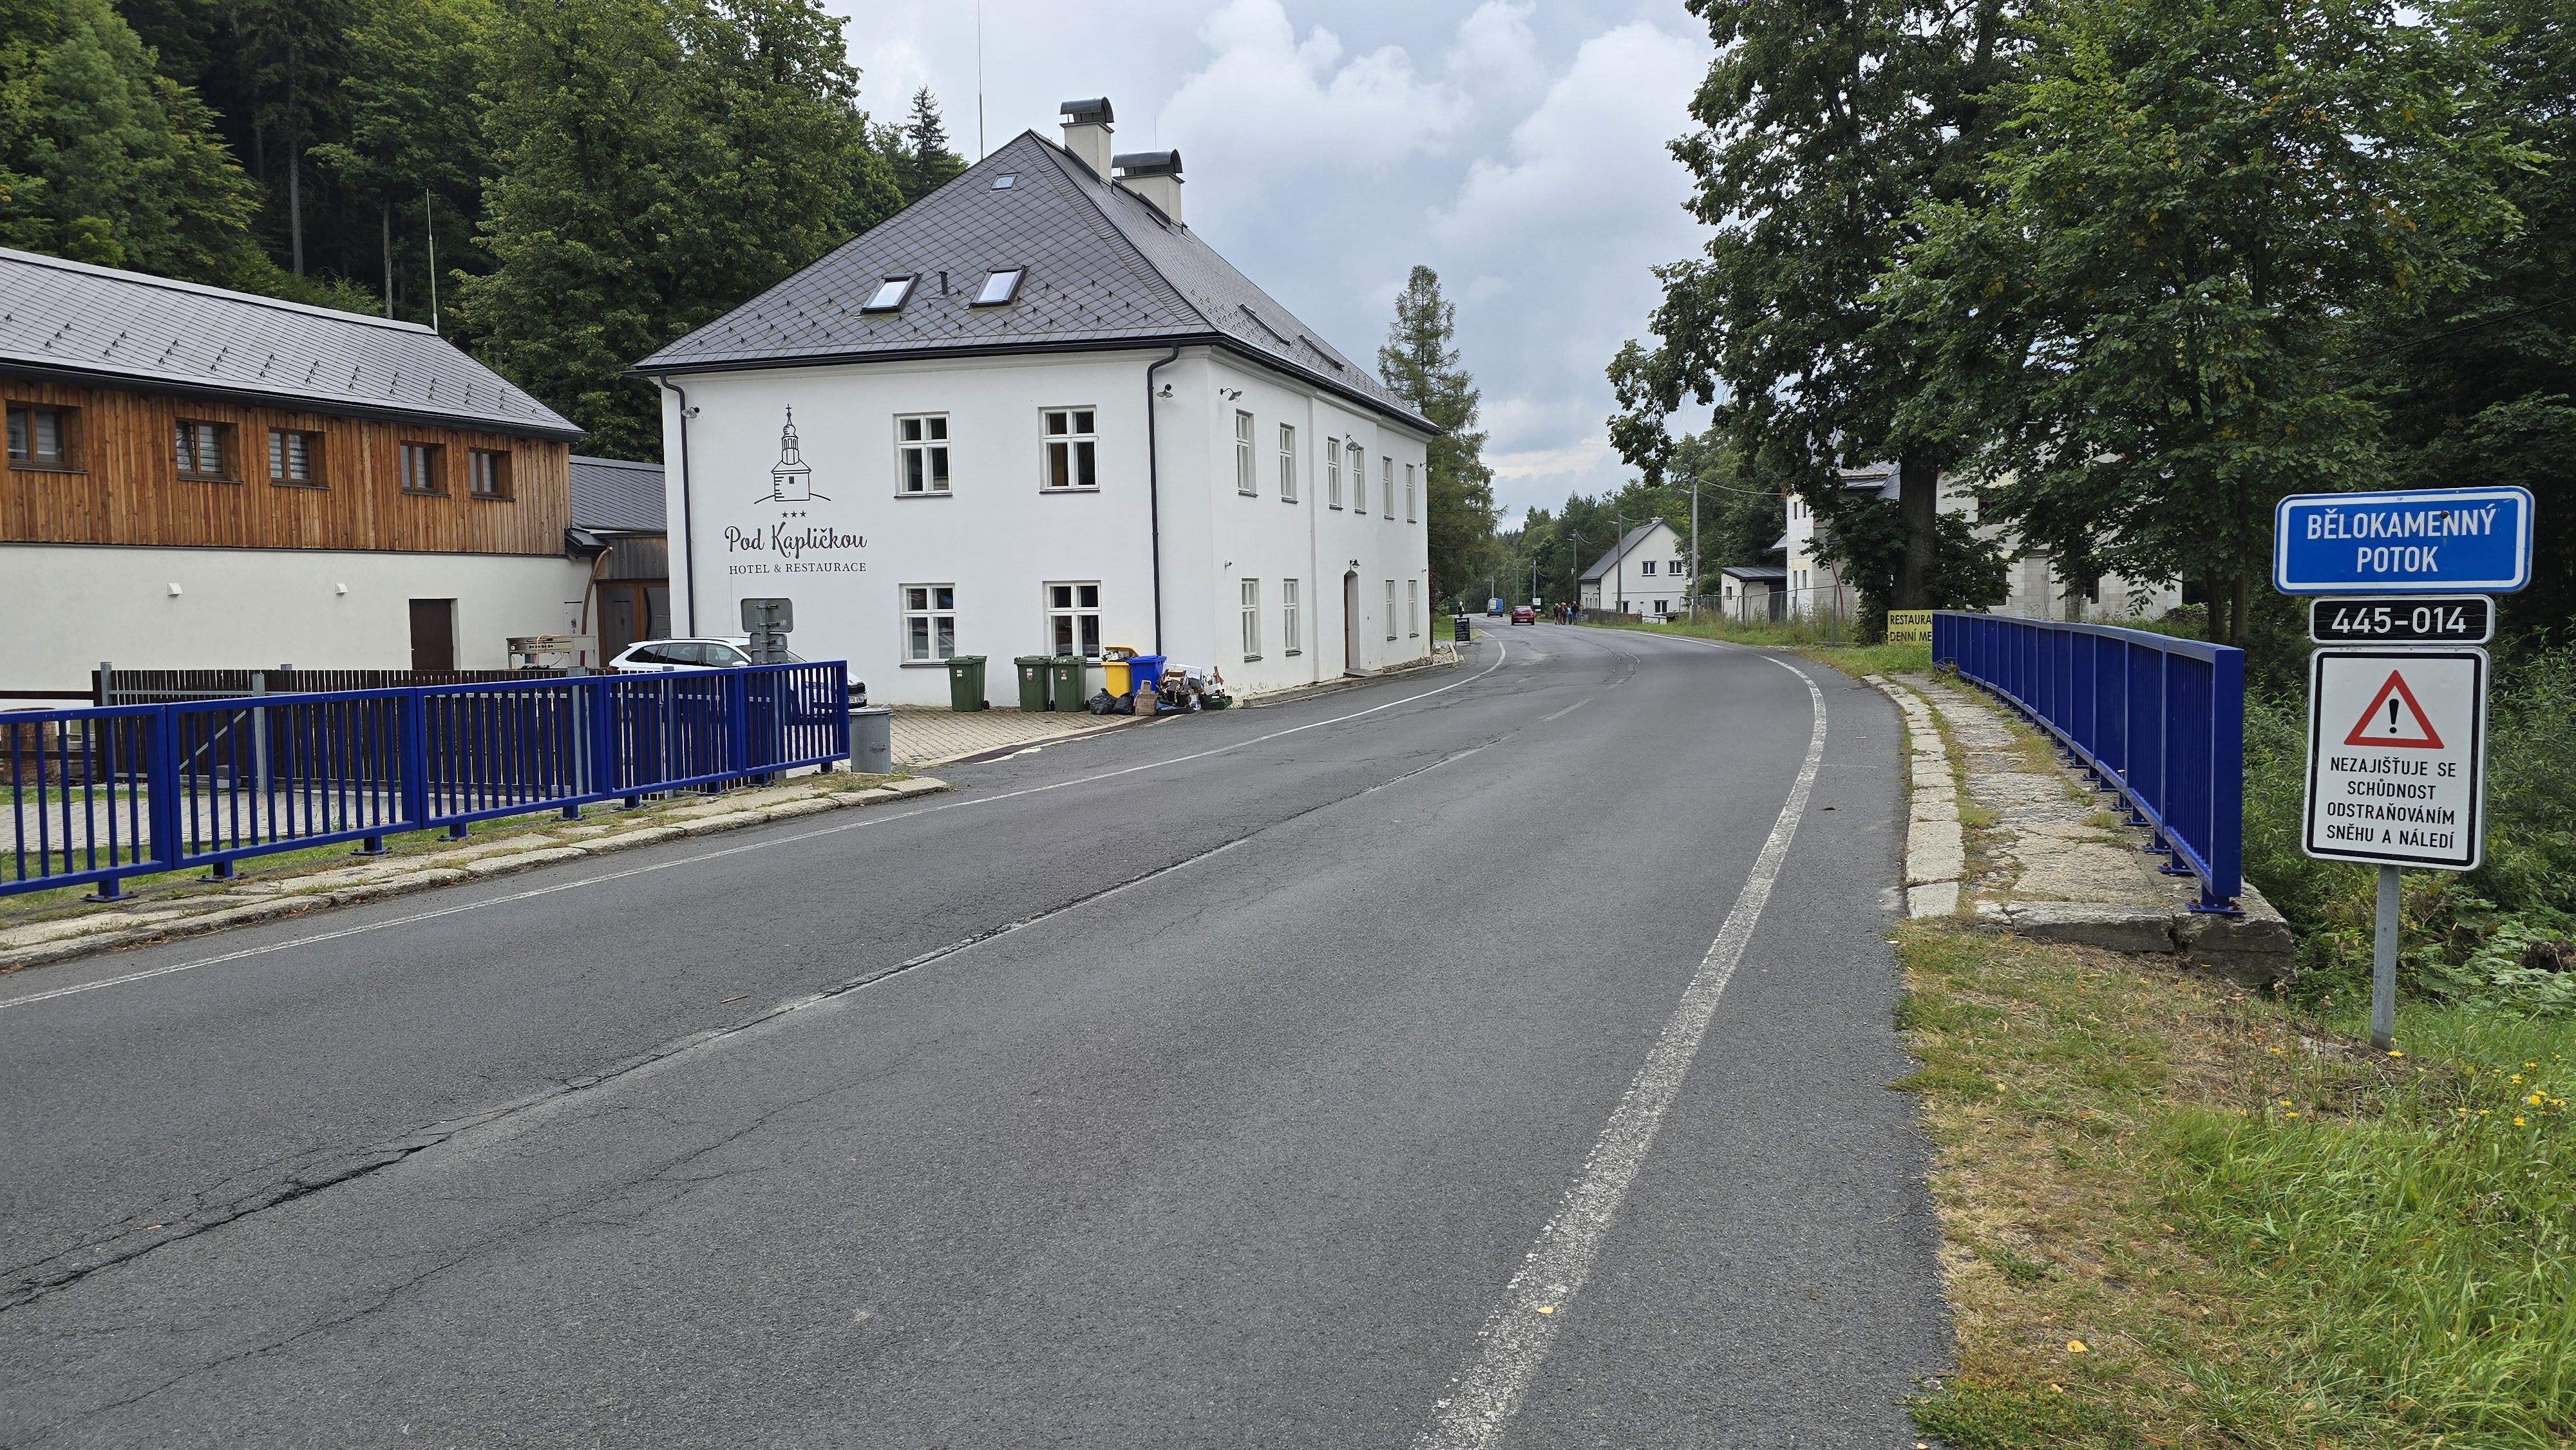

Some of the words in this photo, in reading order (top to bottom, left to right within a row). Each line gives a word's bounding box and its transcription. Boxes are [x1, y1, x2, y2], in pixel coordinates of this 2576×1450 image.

[2307, 504, 2496, 540] BĚLOKAMENNÝ
[724, 525, 765, 552] Pod
[772, 522, 867, 559] Kapličkou
[729, 564, 770, 575] HOTEL
[773, 564, 782, 573] &
[786, 562, 866, 573] RESTAURACE
[2356, 547, 2438, 573] POTOK
[1890, 614, 1932, 625] RESTAURA
[2331, 607, 2467, 634] 445-014
[1890, 628, 1917, 642] DENNÍ
[2330, 756, 2429, 777] NEZAJIŠŤUJE
[2438, 762, 2456, 777] SE
[2347, 778, 2436, 800] SCHŮDNOST
[2327, 802, 2455, 825] ODSTRAŇOVÁNÍM
[2327, 823, 2374, 842] SNĚHU
[2382, 829, 2391, 843] A
[2399, 828, 2454, 849] NÁLEDÍ
